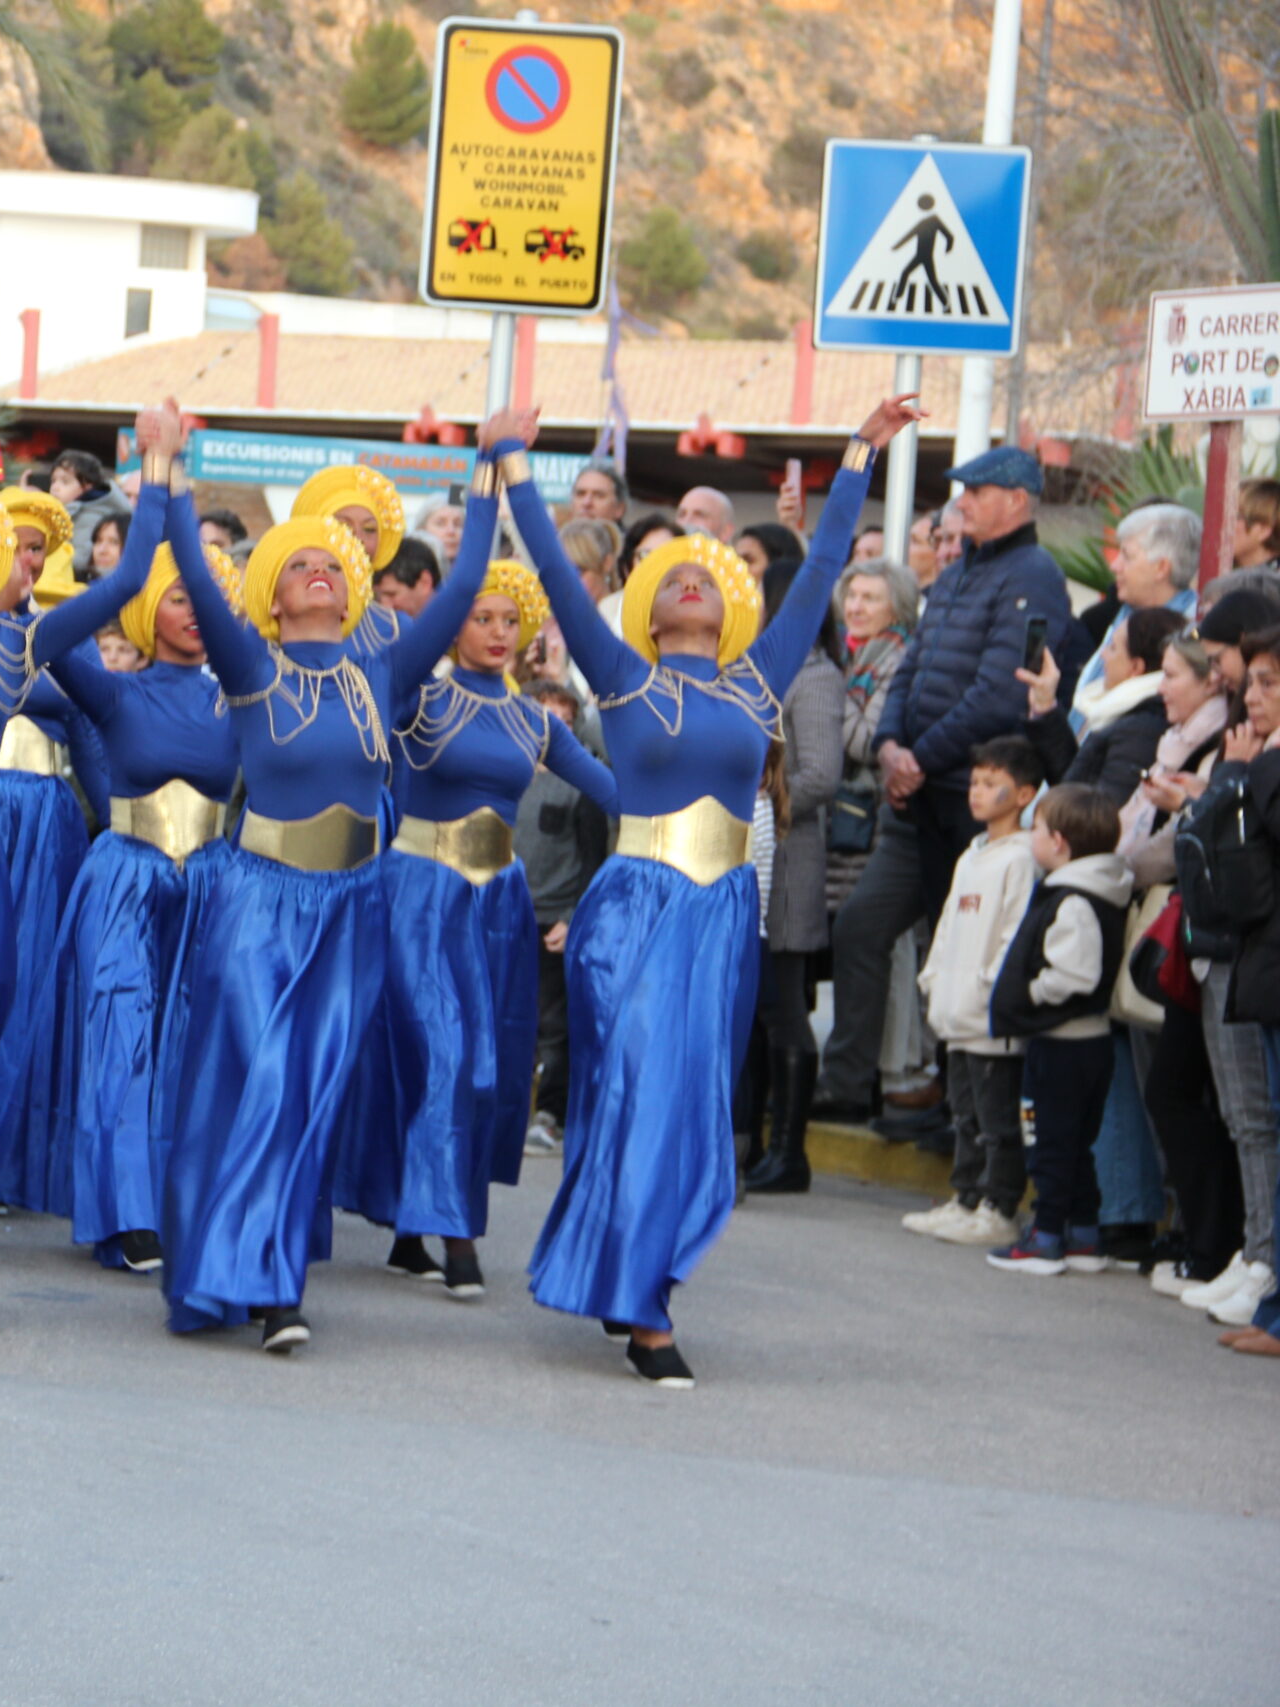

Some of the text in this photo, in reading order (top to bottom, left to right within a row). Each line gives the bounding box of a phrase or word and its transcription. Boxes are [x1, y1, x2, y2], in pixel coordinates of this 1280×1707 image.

[449, 142, 596, 164] AUTOCARAVANAS
[459, 161, 586, 180] Y CARAVANAS
[473, 178, 567, 196] WOHNMOBIL
[479, 195, 560, 212] CARAVAN
[440, 272, 589, 290] EN TODO EL PUERTO
[1200, 312, 1279, 338] CARRER
[1171, 350, 1229, 376] PRT
[201, 440, 326, 465] EXCURSIONES
[328, 449, 355, 466] EN
[357, 452, 468, 473] CATAMARÁN
